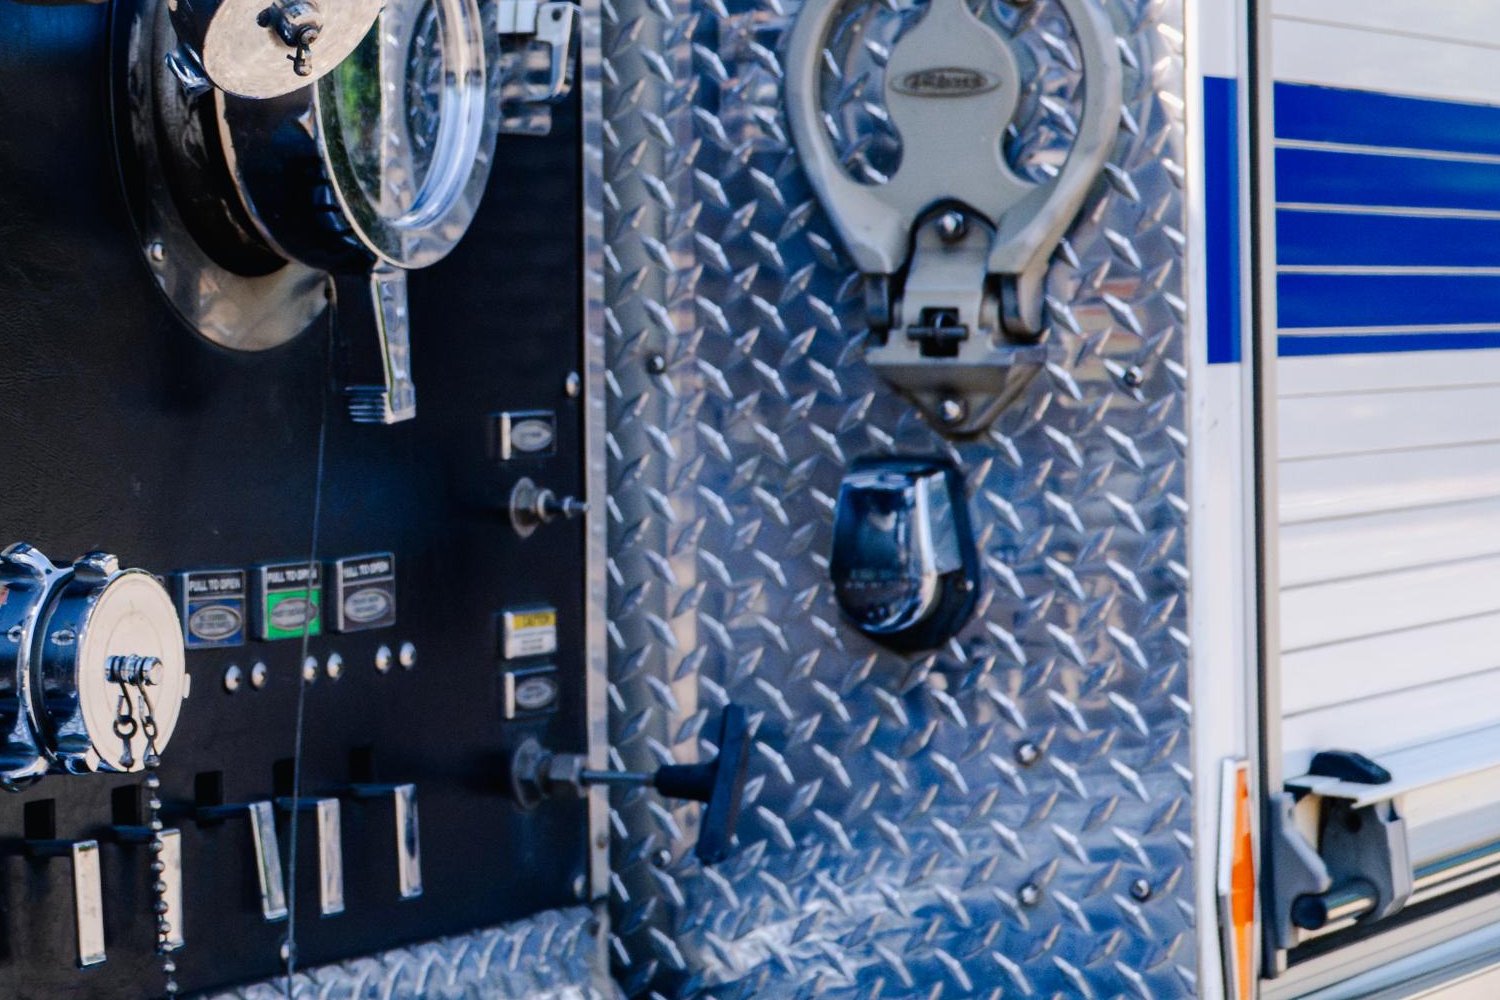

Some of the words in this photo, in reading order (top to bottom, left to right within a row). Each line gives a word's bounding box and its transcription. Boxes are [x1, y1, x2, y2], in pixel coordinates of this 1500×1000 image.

[267, 572, 285, 583] PULL
[285, 570, 297, 581] TO
[359, 564, 371, 577] TO
[371, 561, 389, 574] OPEN
[189, 580, 208, 592] PULL
[208, 578, 220, 590] TO
[220, 577, 241, 589] OPEN
